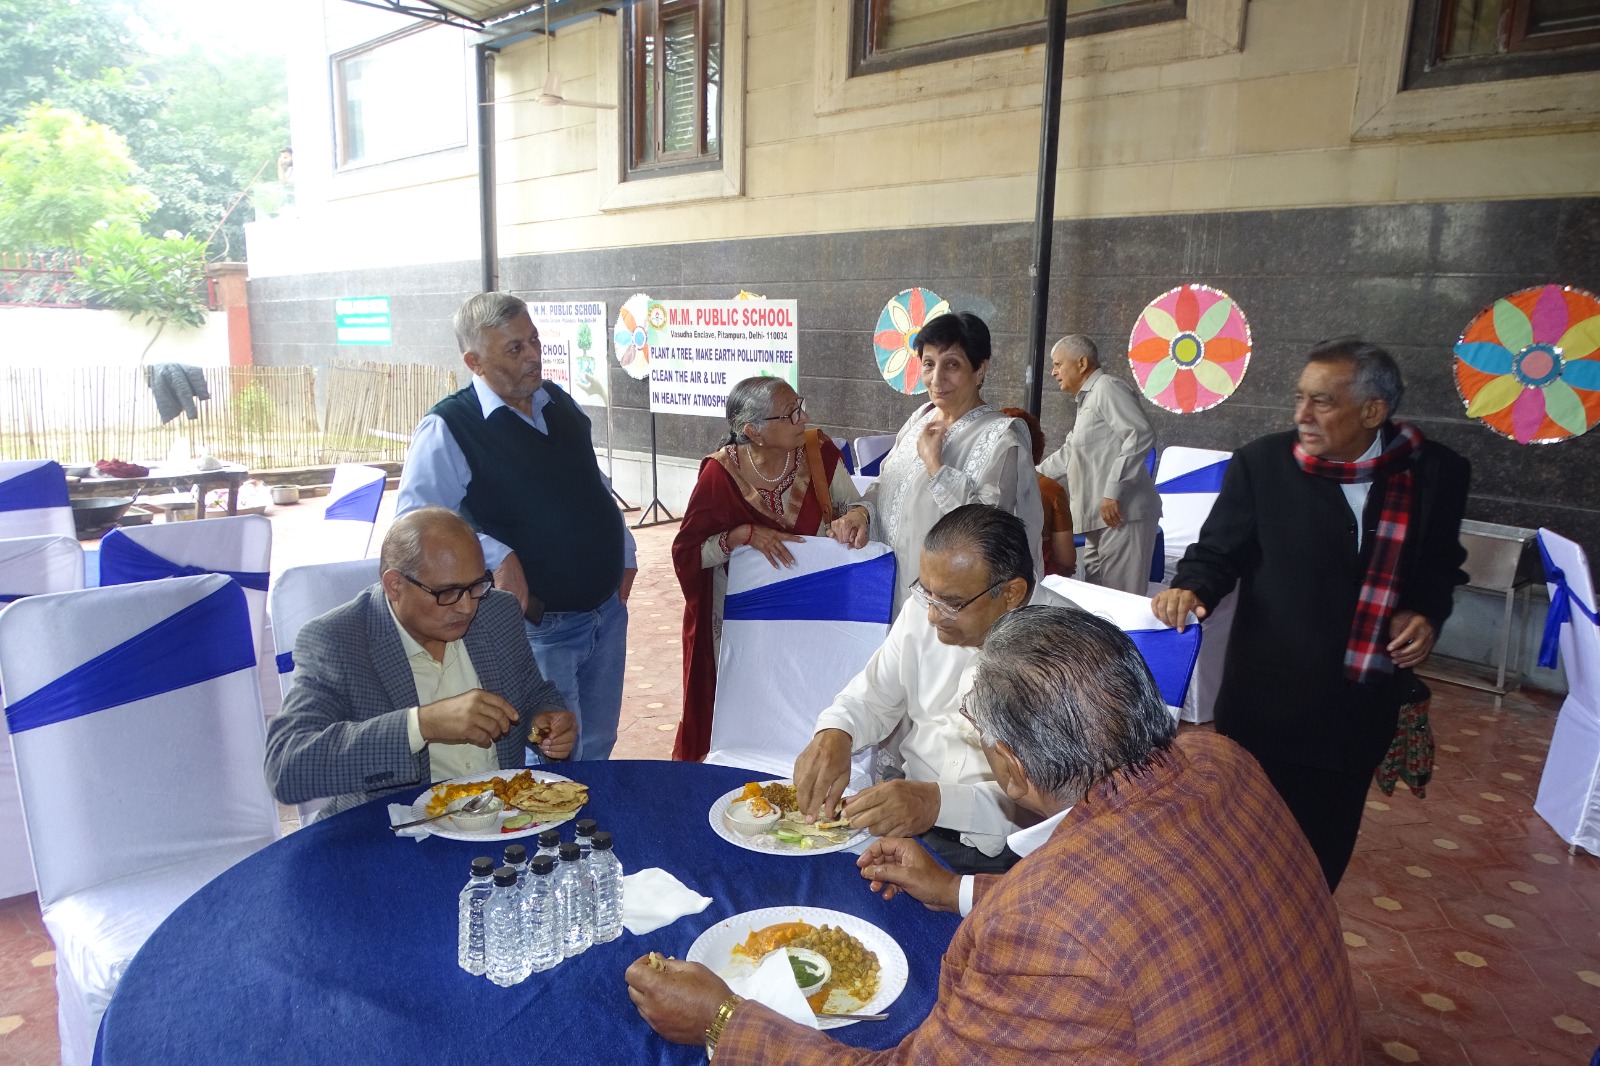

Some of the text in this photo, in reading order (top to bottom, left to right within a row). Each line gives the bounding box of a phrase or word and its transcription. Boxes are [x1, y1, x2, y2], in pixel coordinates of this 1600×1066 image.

[550, 304, 572, 316] PUBLIC
[574, 304, 602, 316] SCHOOL
[669, 308, 693, 326] M.M.
[696, 308, 739, 326] PUBLIC
[742, 308, 793, 327] SCHOOL
[670, 330, 692, 338] Vasudha
[694, 330, 716, 340] Enclave,
[718, 330, 748, 340] Pitampura,
[766, 331, 788, 340] 110034
[542, 344, 567, 356] CHOOL
[650, 346, 792, 364] PLANT A TREE, MAKE EARTH POLLUTION FREE
[544, 368, 568, 381] FESTIVAL
[652, 370, 726, 385] CLEAN THE AIR & LIVE
[652, 392, 729, 408] IN HEALTHY ATMOSPH
